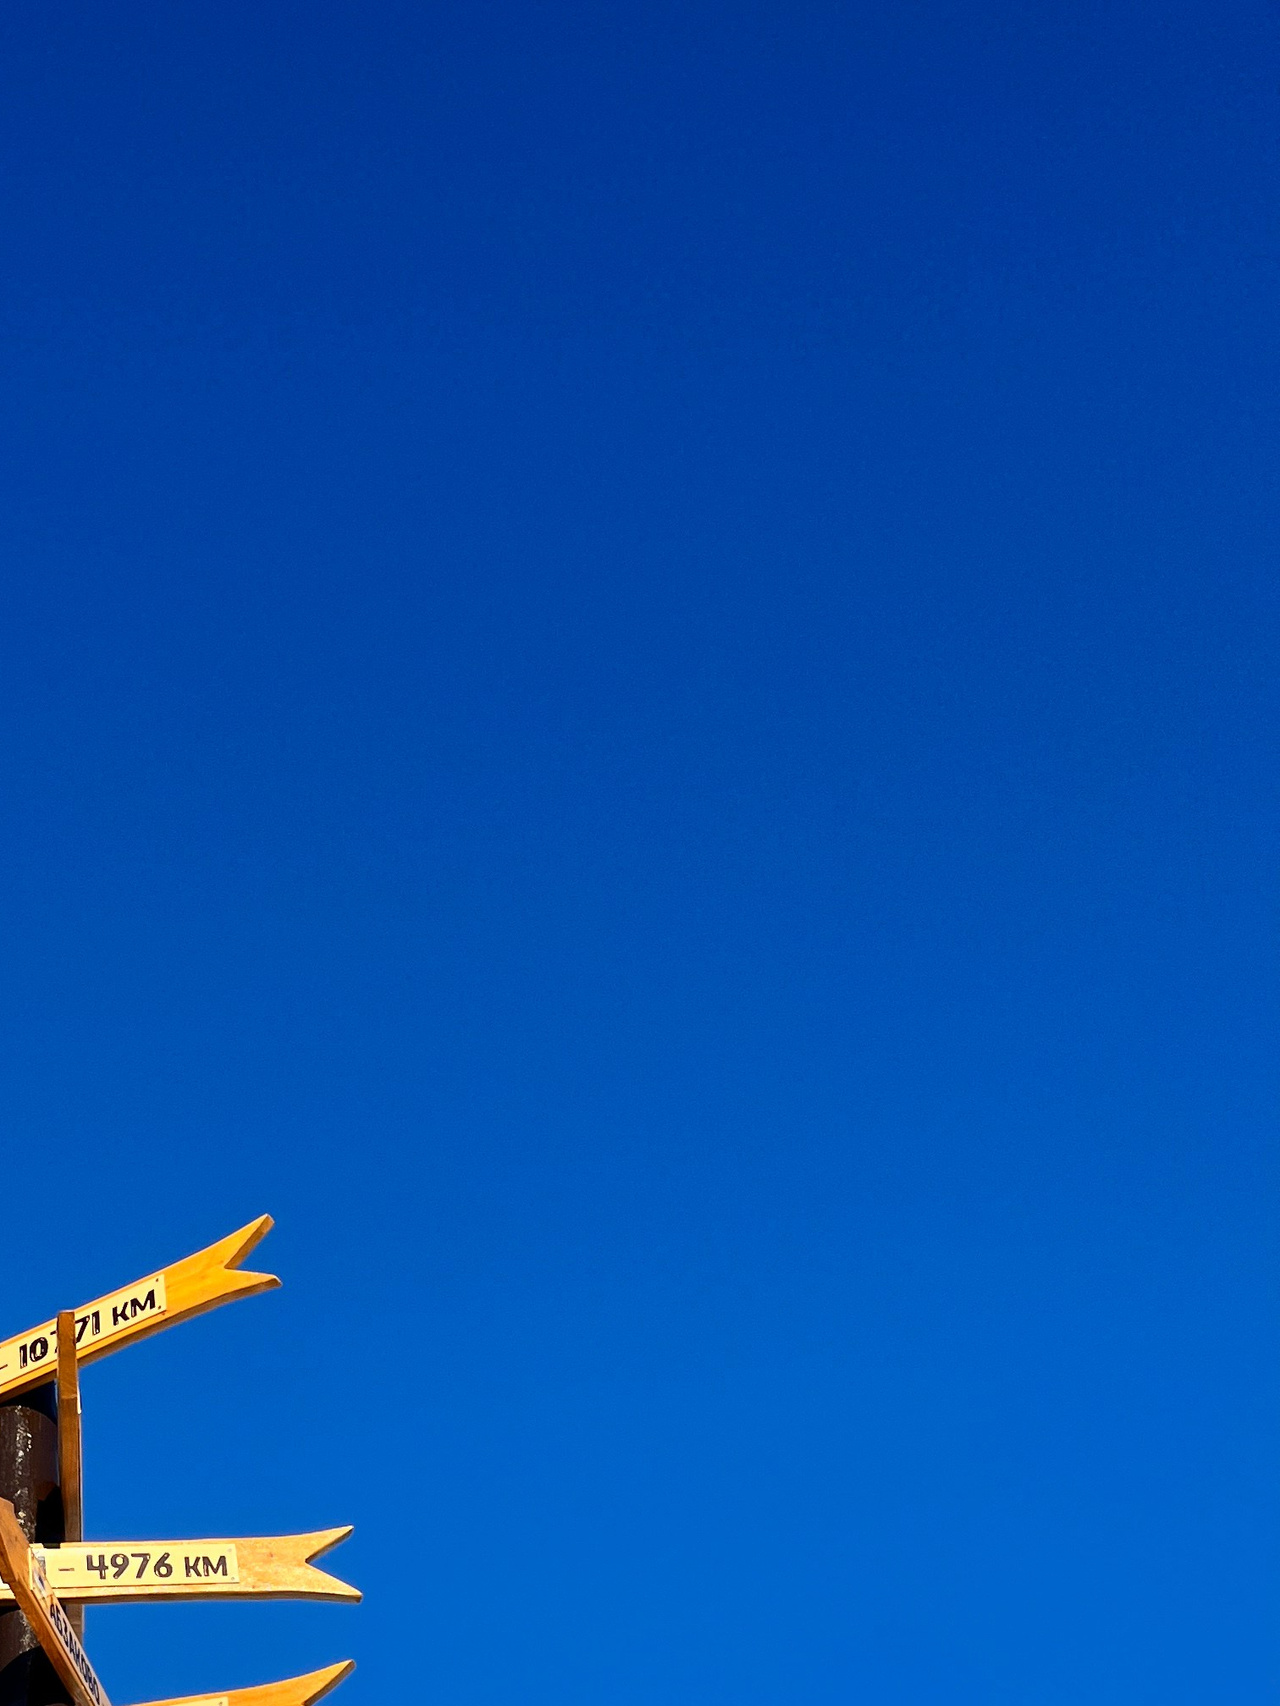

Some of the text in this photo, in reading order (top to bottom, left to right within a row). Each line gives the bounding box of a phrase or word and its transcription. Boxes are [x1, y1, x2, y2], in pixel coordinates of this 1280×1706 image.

[19, 1310, 101, 1369] 1071
[111, 1289, 156, 1326] КМ
[87, 1553, 172, 1579] 4976
[185, 1556, 227, 1577] КМ
